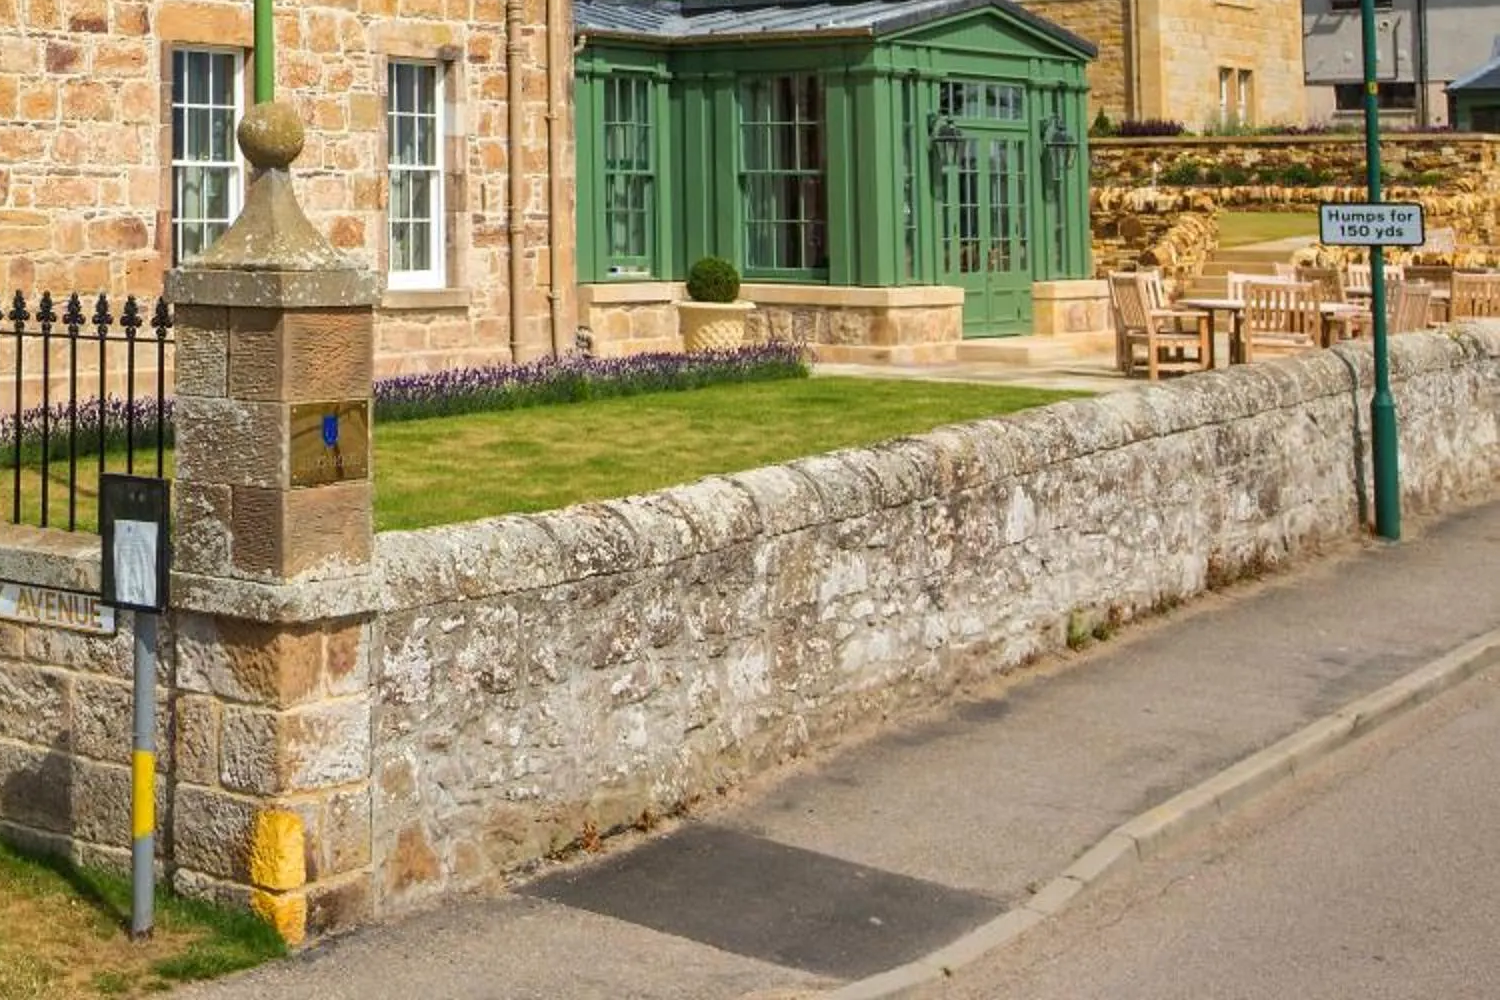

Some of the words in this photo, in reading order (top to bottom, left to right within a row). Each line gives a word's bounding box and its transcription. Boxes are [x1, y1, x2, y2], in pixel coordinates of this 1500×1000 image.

[1328, 209, 1385, 223] Humps
[1391, 209, 1413, 222] for
[1340, 225, 1370, 237] 150
[1375, 226, 1404, 239] yds
[15, 588, 103, 628] AVENUE
